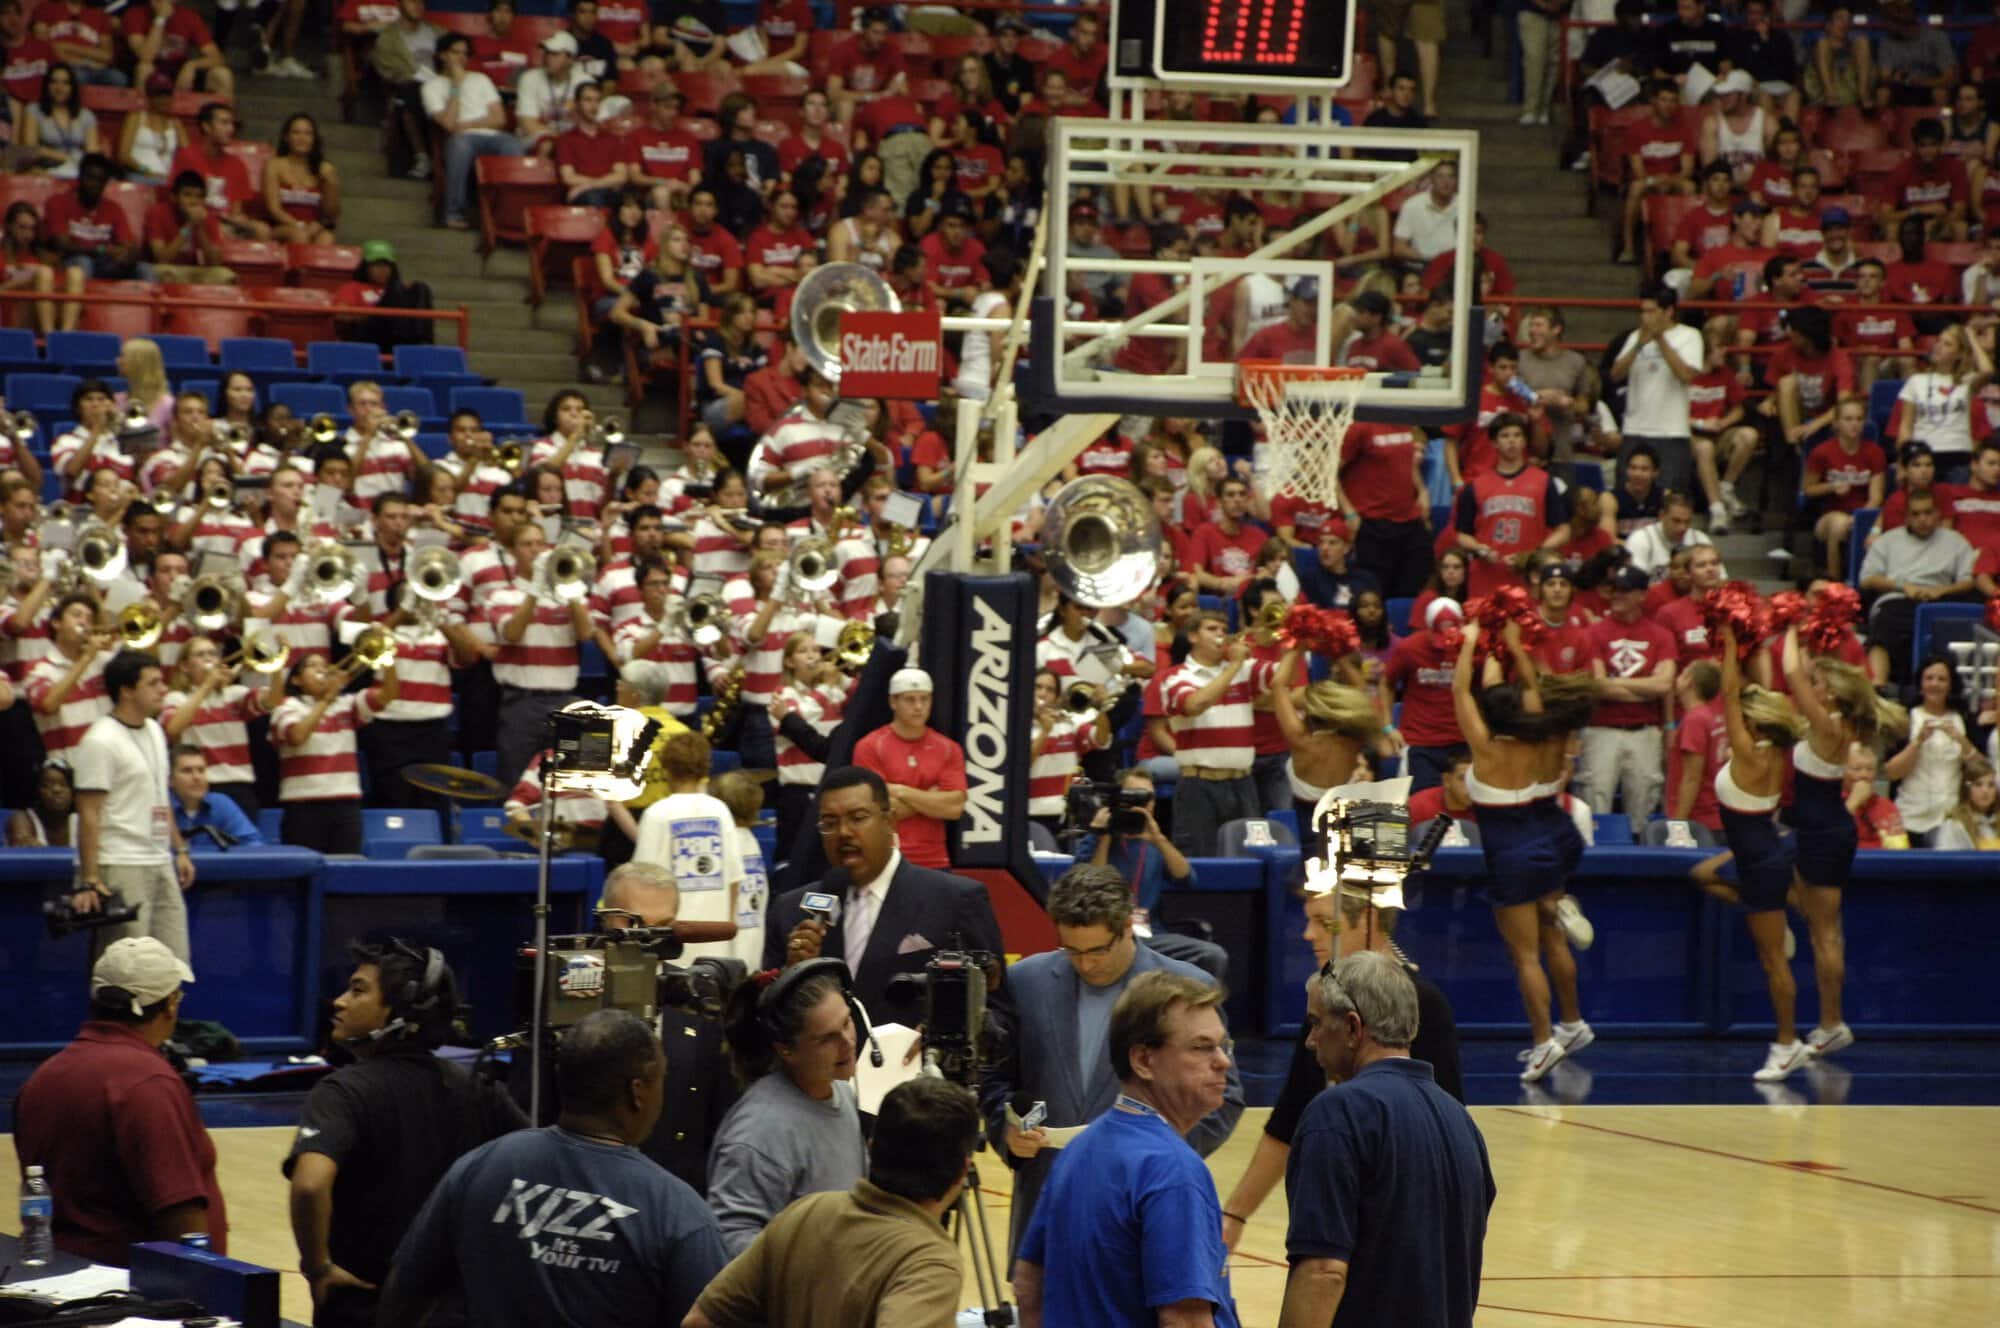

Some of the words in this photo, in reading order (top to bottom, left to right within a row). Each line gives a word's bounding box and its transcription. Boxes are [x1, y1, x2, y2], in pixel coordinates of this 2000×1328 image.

[842, 332, 889, 372] State
[889, 332, 937, 373] Farm
[961, 595, 1013, 843] ARIZONA
[530, 1241, 586, 1269] Your
